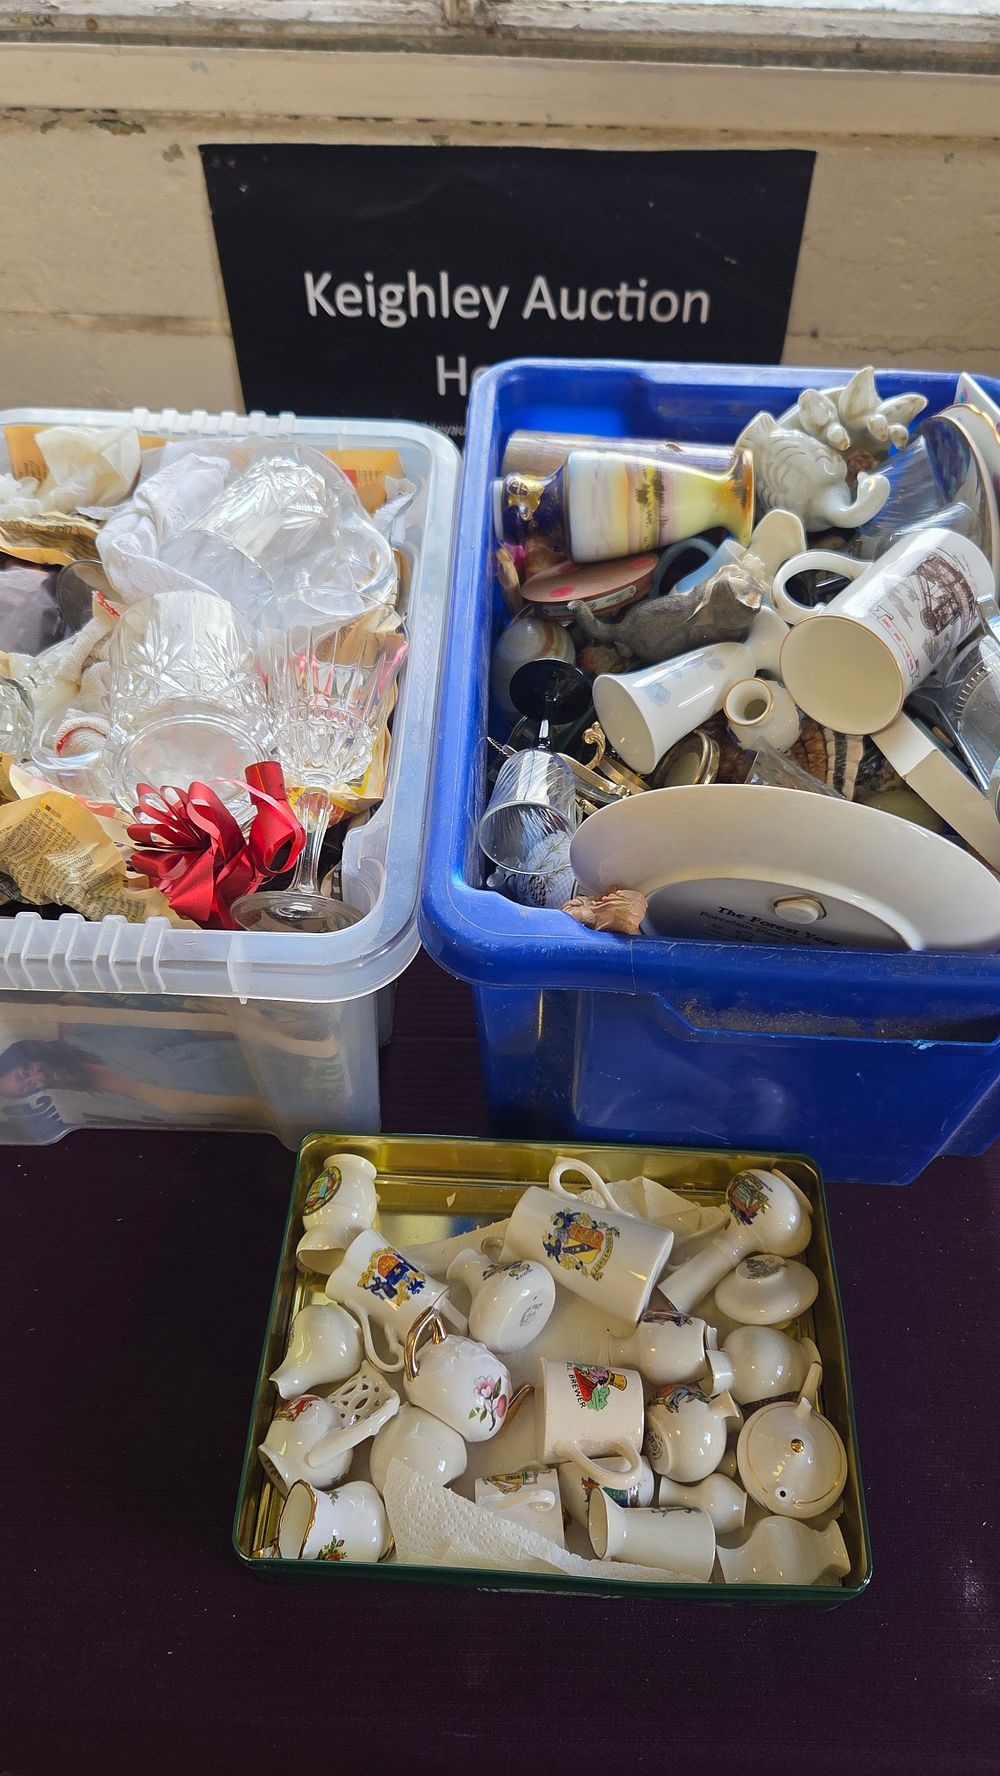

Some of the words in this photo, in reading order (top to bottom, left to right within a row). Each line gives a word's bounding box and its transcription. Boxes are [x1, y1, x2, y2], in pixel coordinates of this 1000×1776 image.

[304, 269, 508, 328] Keighley
[522, 276, 710, 323] Auction
[700, 911, 751, 930] Porcelain
[718, 906, 745, 920] The
[750, 915, 800, 935] Forest
[805, 931, 840, 946] Year
[568, 1374, 587, 1409] BREWER
